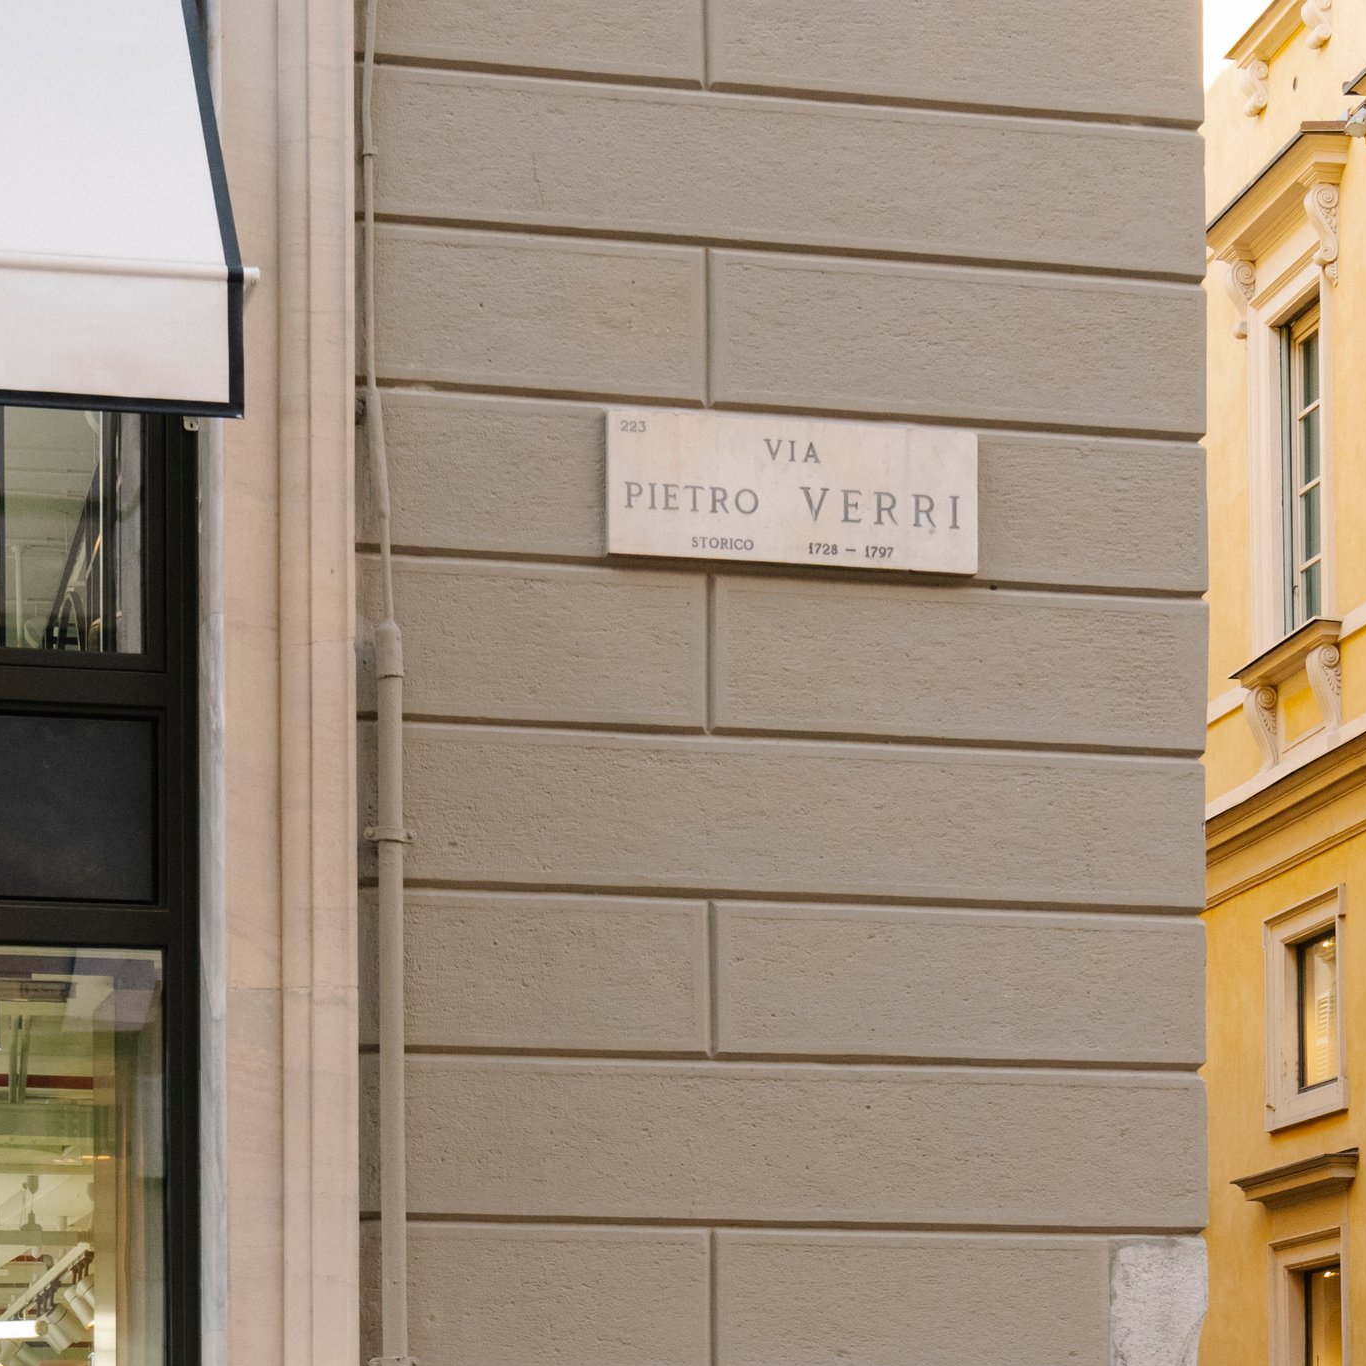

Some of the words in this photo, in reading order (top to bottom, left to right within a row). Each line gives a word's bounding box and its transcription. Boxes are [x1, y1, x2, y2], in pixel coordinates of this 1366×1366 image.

[620, 420, 646, 433] 223
[764, 438, 821, 463] VIA
[624, 481, 760, 514] PIETRO
[800, 486, 961, 529] VERRI
[691, 536, 755, 551] STORICO
[808, 542, 838, 556] 1728
[865, 546, 894, 558] 1797
